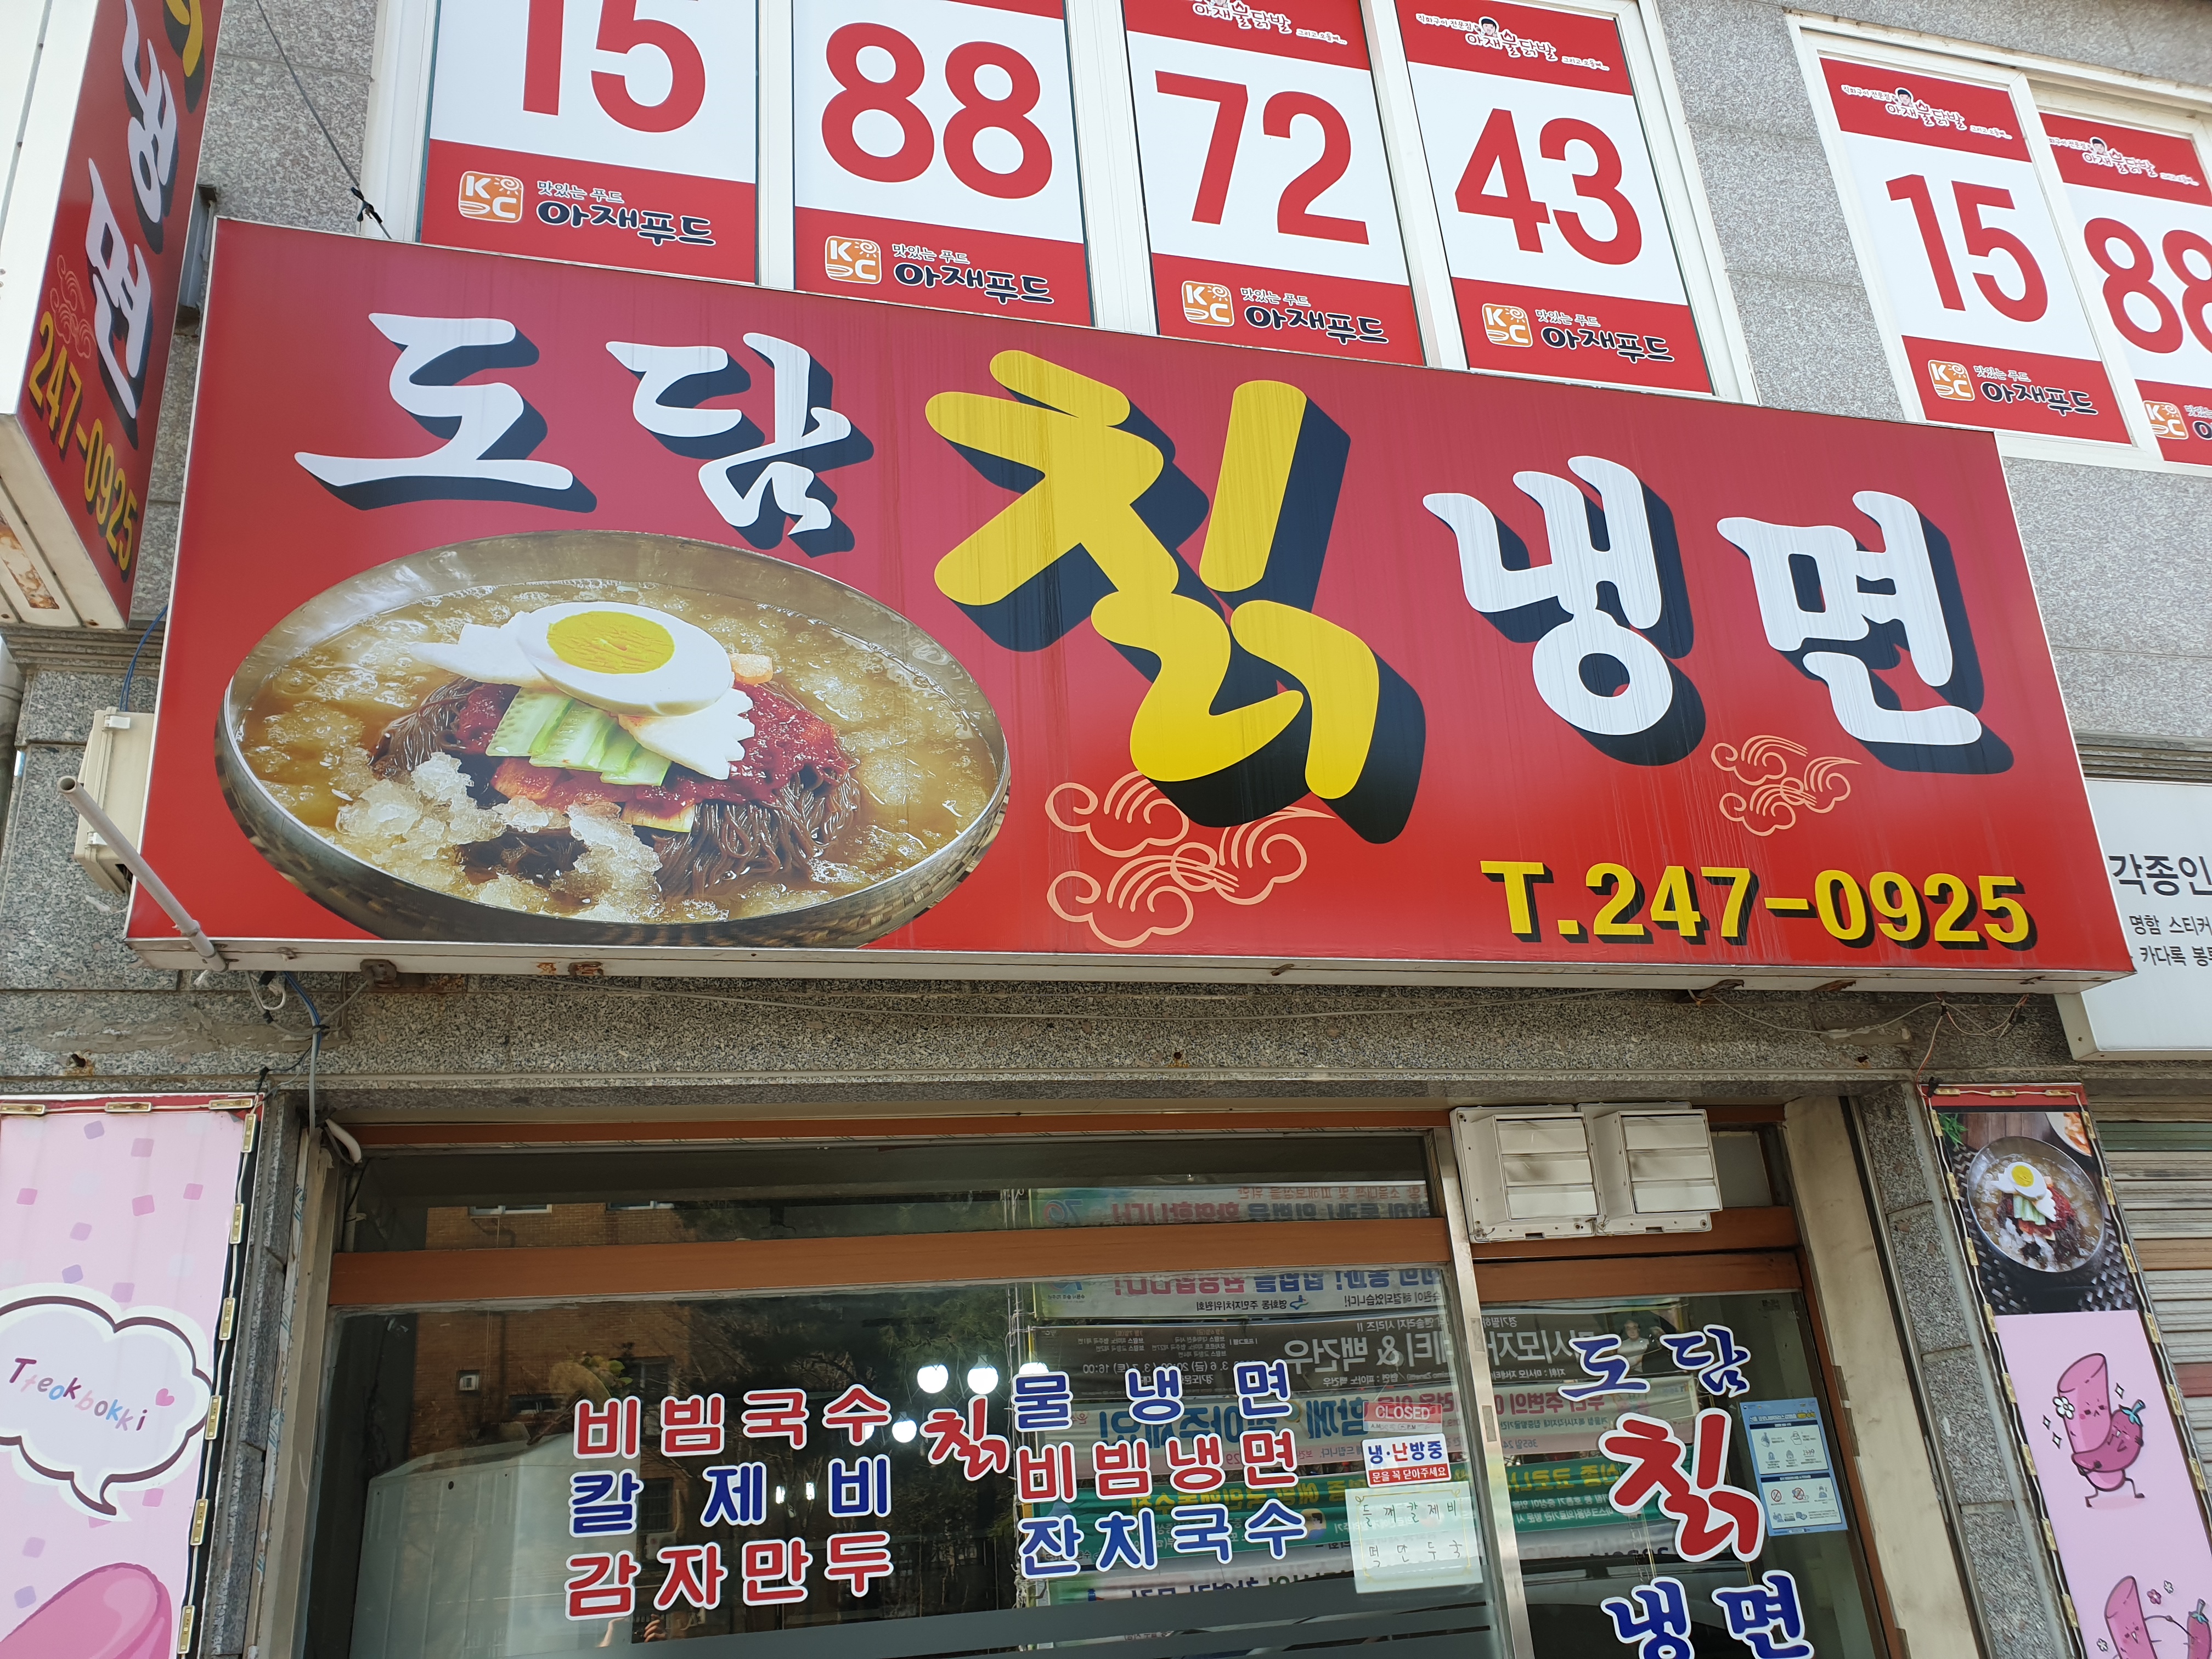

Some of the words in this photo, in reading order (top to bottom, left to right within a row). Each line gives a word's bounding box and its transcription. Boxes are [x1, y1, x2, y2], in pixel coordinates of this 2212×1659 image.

[523, 0, 706, 132] 15
[822, 22, 1052, 199] 88
[537, 180, 586, 200] 맛있는
[593, 188, 624, 204] 푸드
[1155, 70, 1369, 245] 72
[1455, 108, 1641, 265] 43
[536, 200, 716, 246] 아재푸드
[891, 242, 936, 262] 맛있는
[939, 250, 970, 264] 푸드
[1886, 174, 2048, 322] 15
[893, 262, 1054, 304] 아재푸드
[1240, 287, 1281, 305] 맛있는
[1283, 293, 1311, 307] 푸드
[1535, 309, 1573, 326] 맛있는
[1575, 314, 1601, 328] 푸드
[2084, 217, 2212, 356] 88
[1244, 306, 1389, 345] 아재푸드
[1541, 326, 1674, 364] 아재푸드
[1973, 365, 2007, 381] 맛있는
[2007, 370, 2031, 383] 푸드
[1980, 381, 2098, 416] 아재푸드
[29, 312, 137, 571] 247-0925
[294, 313, 851, 535] 도담
[925, 350, 1379, 799] 칡
[1423, 456, 1981, 744] 냉면
[1480, 861, 2029, 943] T.247-0925
[2129, 915, 2162, 935] 명함
[2169, 916, 2212, 936] 스티커
[2140, 945, 2187, 967] 카다록
[1558, 1323, 1751, 1402] 도담
[573, 1384, 891, 1459] 비빔국수
[921, 1394, 1009, 1481] 칡
[1375, 1406, 1431, 1420] CLOSED
[1014, 1429, 1298, 1504] 비빔냉면
[1372, 1471, 1390, 1483] 문을
[1392, 1470, 1401, 1481] 꼭
[1403, 1466, 1446, 1481] 닫아주세요
[1598, 1408, 1765, 1563] 칡
[565, 1531, 894, 1621] 감자만두
[1018, 1498, 1310, 1579] 잔치국수
[1600, 1570, 1814, 1659] 냉면
